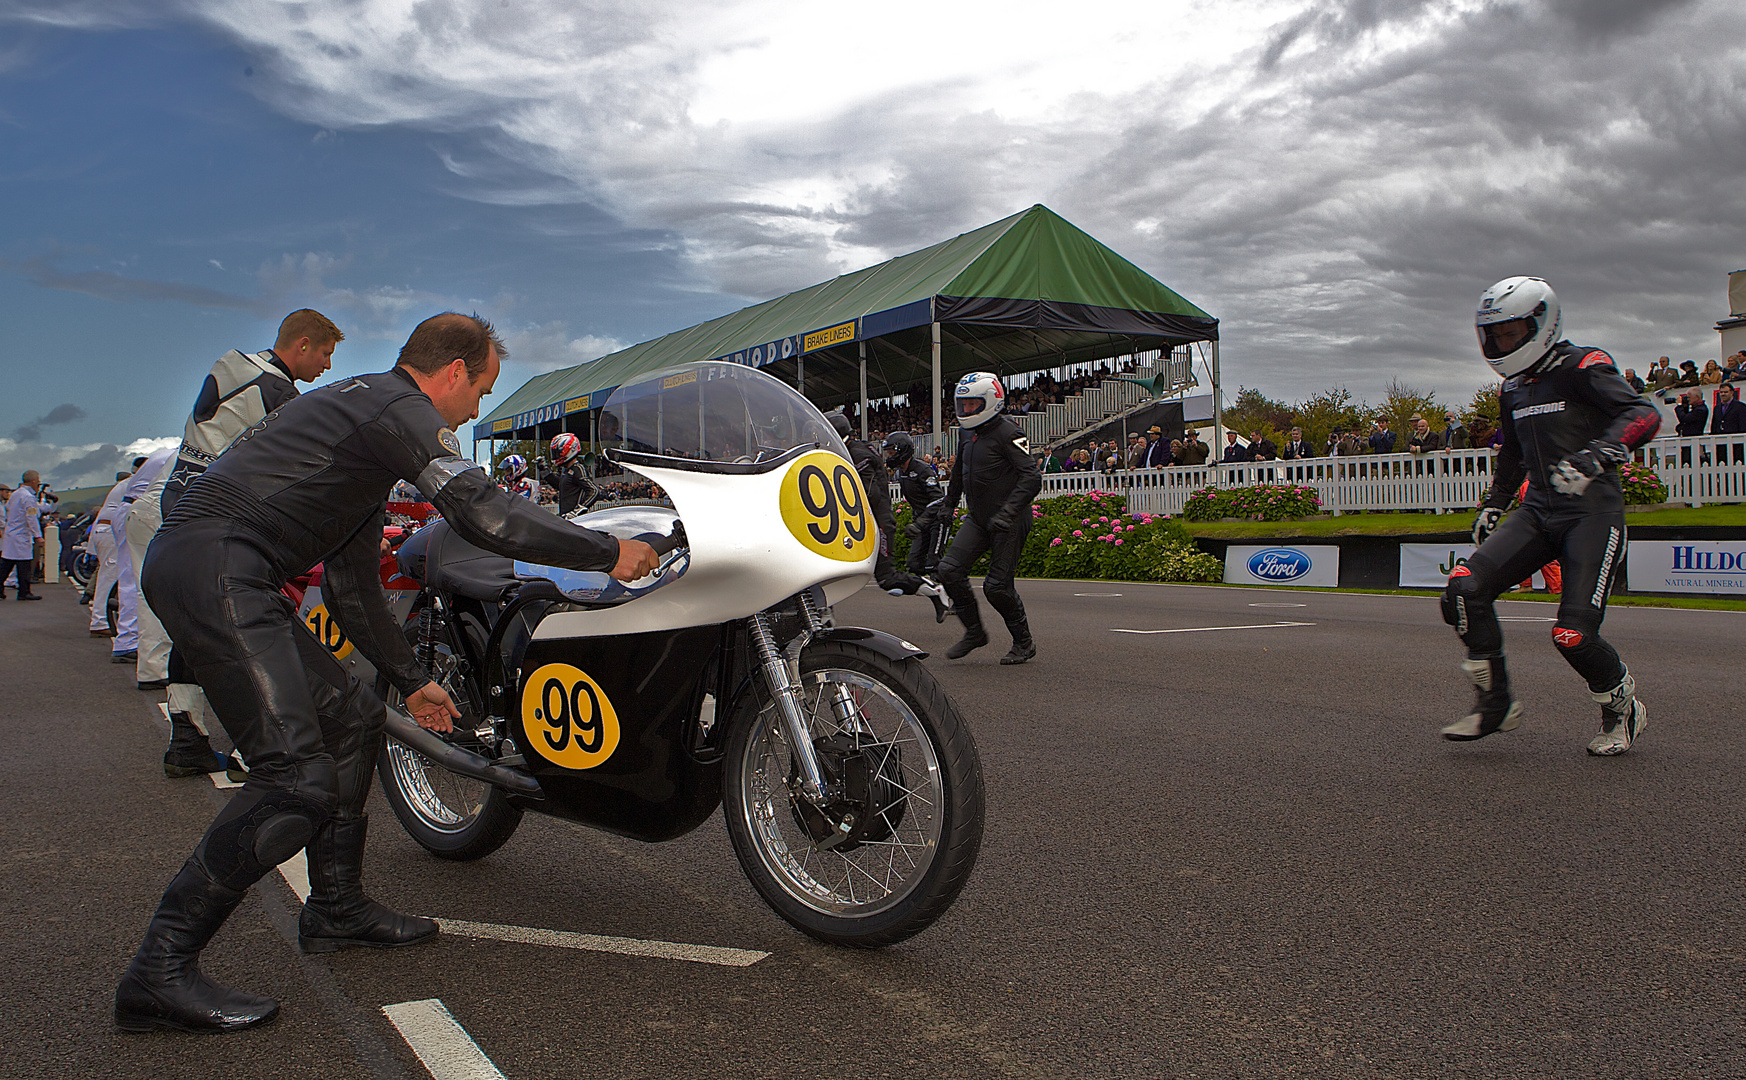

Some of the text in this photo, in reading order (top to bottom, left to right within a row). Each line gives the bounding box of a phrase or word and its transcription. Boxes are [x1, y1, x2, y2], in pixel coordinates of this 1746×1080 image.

[807, 326, 852, 348] BRAKE LINERS
[517, 404, 560, 430] FERODO
[798, 464, 866, 545] 99
[1257, 552, 1299, 576] Ford
[1590, 526, 1620, 609] BRIDGESTONE
[1665, 579, 1745, 588] NATURAL MINERAL
[542, 677, 604, 754] 99
